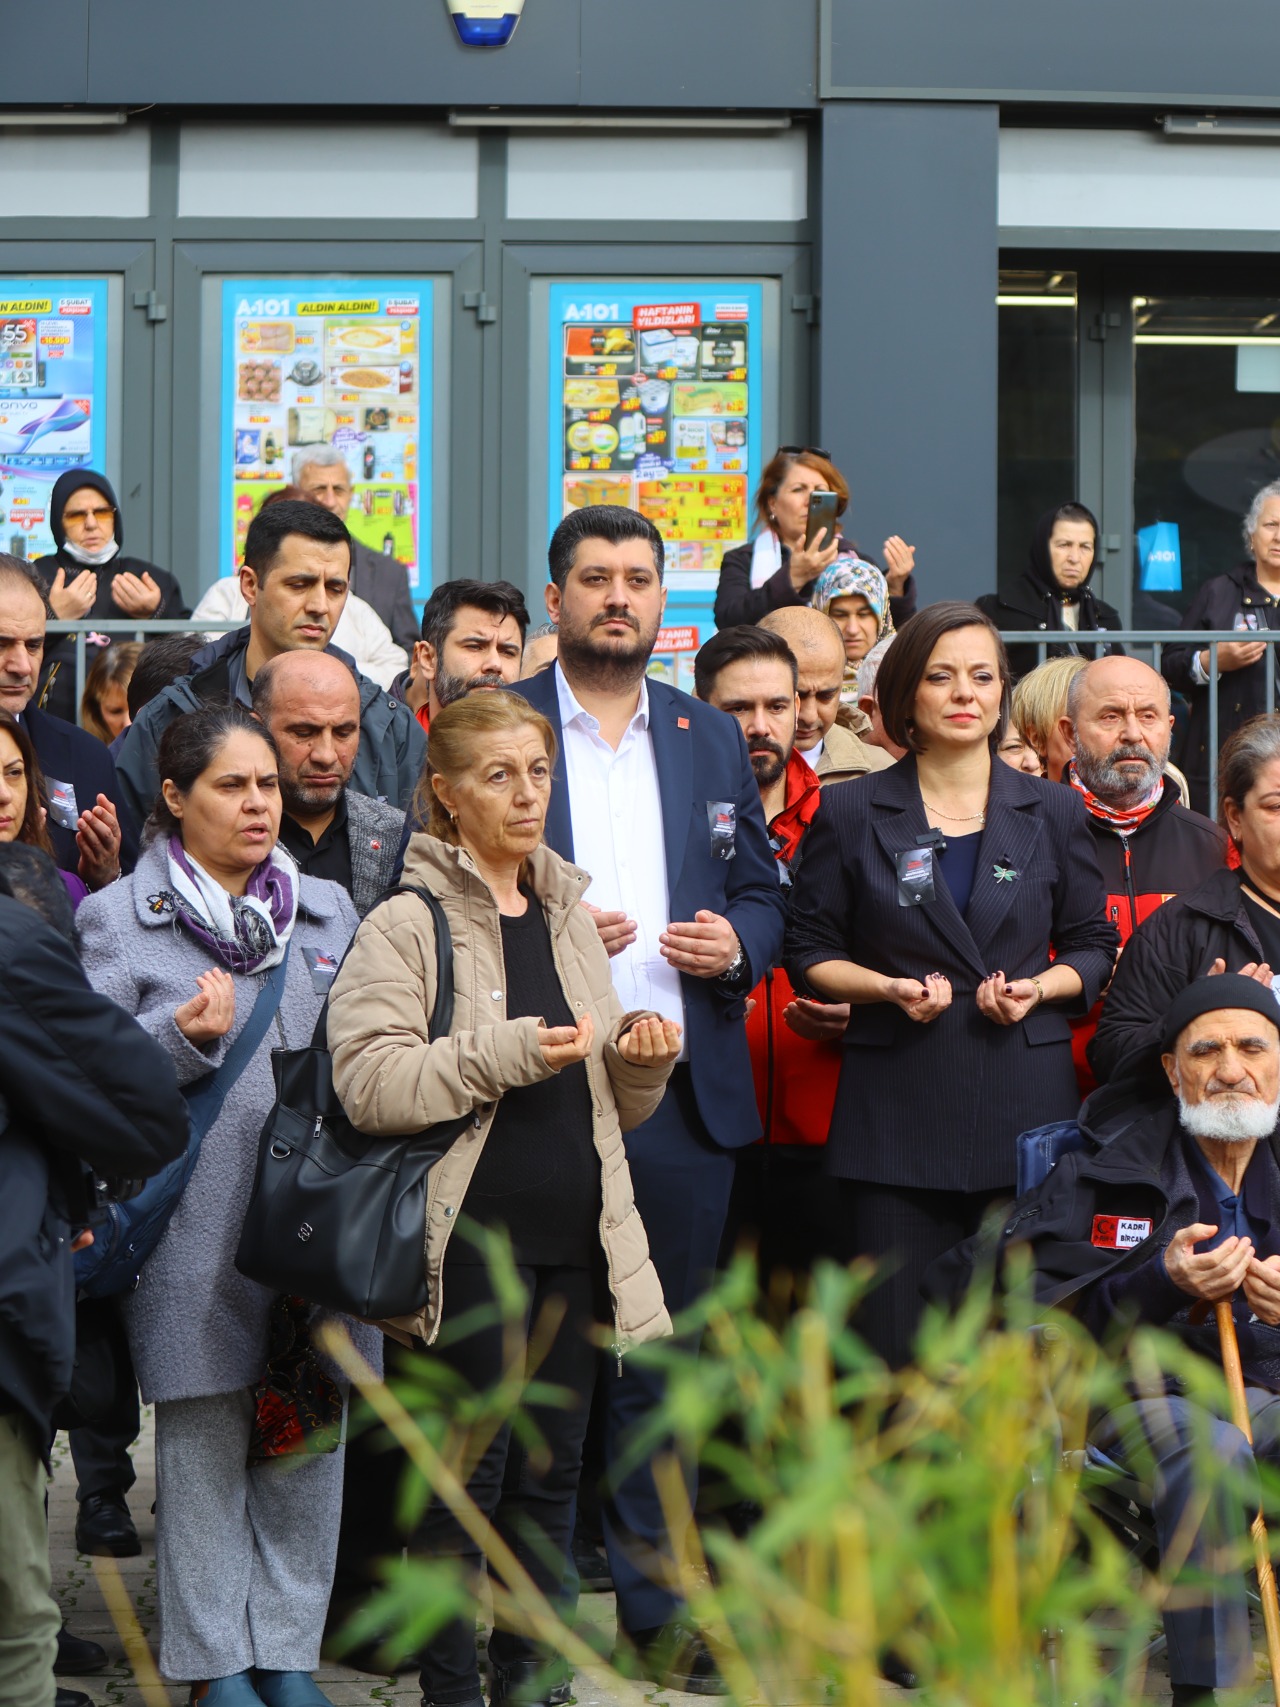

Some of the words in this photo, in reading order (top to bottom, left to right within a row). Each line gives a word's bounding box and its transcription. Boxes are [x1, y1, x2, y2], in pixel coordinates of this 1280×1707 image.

[10, 300, 48, 311] ALDIN!
[302, 302, 335, 312] ALDIN
[337, 301, 376, 311] ALDIN!
[638, 305, 694, 317] HAFTANIN
[637, 315, 695, 326] YILDIZLARI
[658, 629, 693, 639] TANIN
[654, 638, 694, 648] DIZLARI
[1121, 1222, 1146, 1231] KADRİ
[1120, 1234, 1144, 1242] BİRCAN
